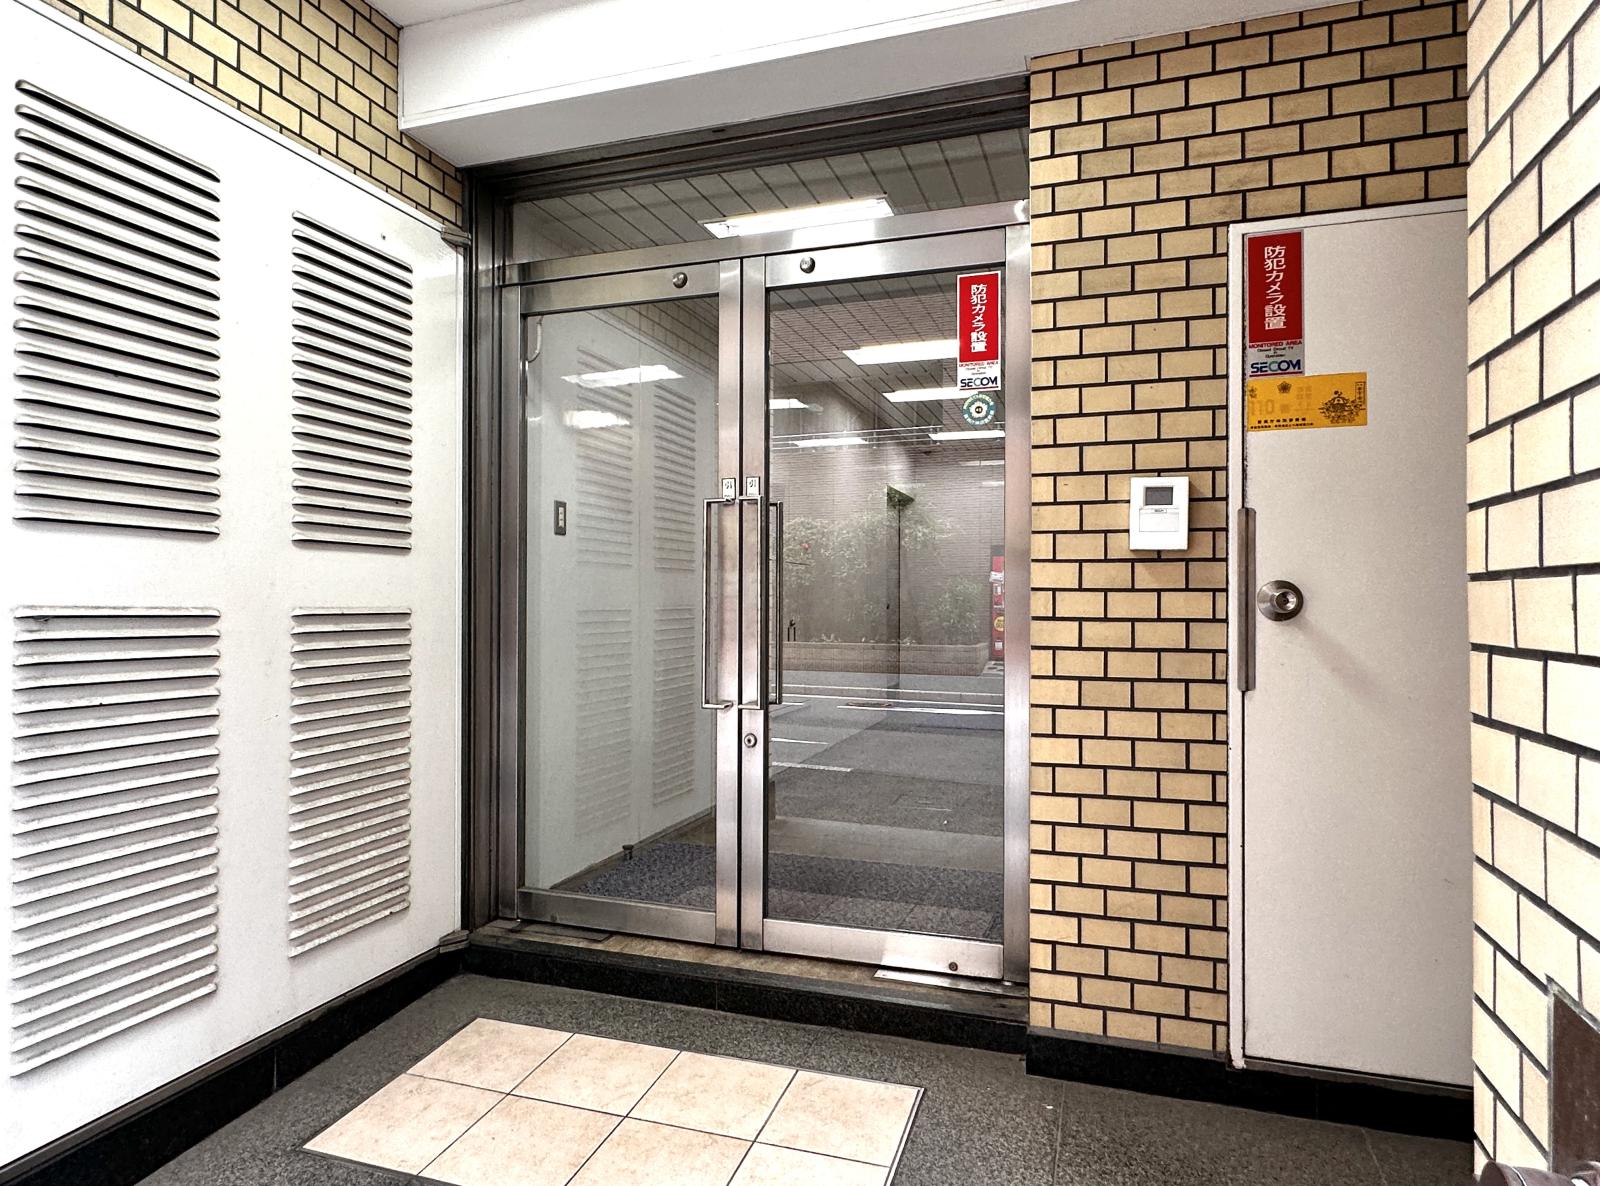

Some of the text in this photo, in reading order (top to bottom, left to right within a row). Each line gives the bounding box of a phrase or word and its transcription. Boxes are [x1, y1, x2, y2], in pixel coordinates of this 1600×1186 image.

[1263, 245, 1287, 330] 防犯カメラ設置
[970, 284, 988, 353] 防犯カメラ設置
[960, 376, 998, 388] SECOM
[1250, 359, 1301, 373] SECOM
